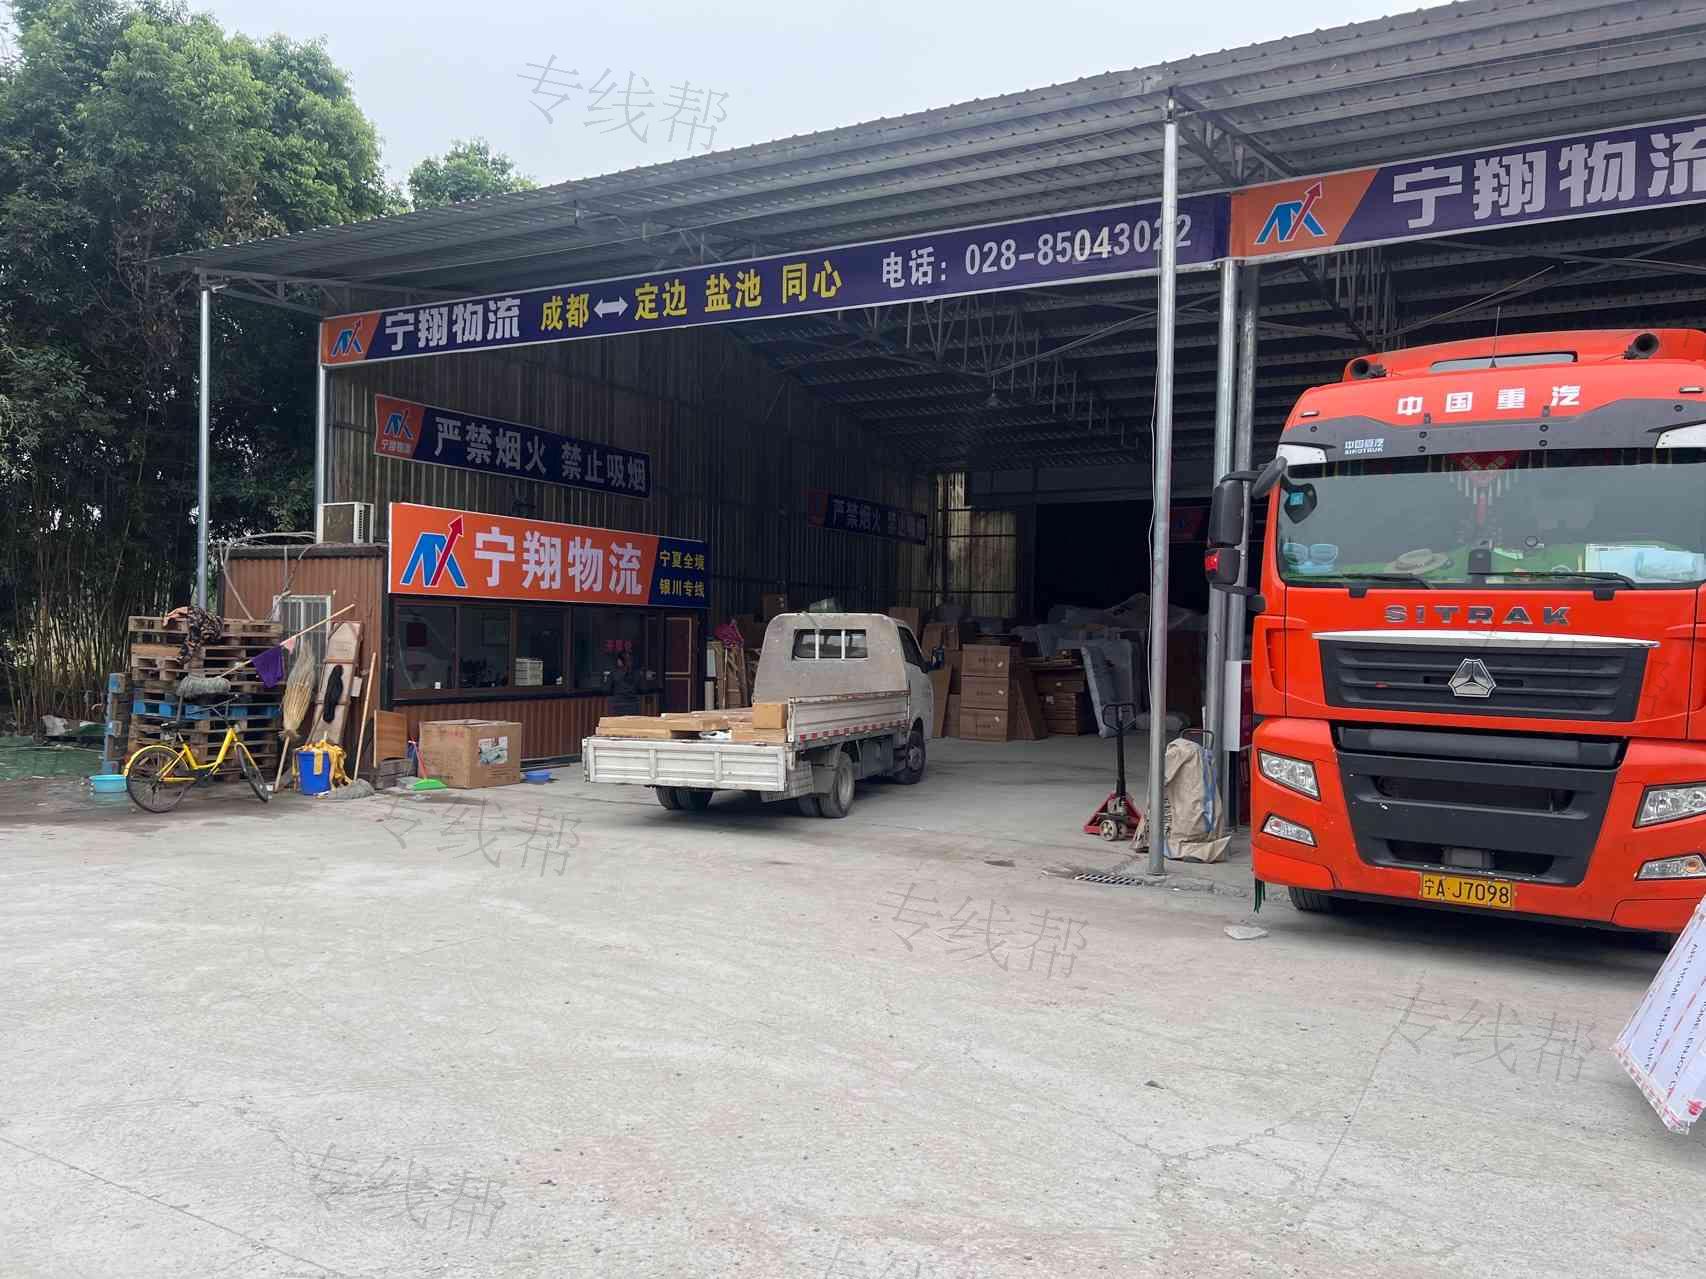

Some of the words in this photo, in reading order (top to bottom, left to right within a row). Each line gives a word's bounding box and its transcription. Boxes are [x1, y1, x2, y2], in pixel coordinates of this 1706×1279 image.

[1392, 128, 1706, 230] 宁翔物流
[384, 297, 521, 352] 宁翔物流
[539, 292, 590, 332] 成都
[633, 279, 688, 321] 定边
[703, 268, 762, 313] 盐池
[782, 260, 843, 304] 同心
[1396, 385, 1582, 416] 中国重汽
[434, 415, 547, 475] 严禁烟火
[561, 441, 647, 492] 禁止吸烟
[474, 526, 643, 595] 宁翔物流
[1383, 605, 1572, 626] SITRAK
